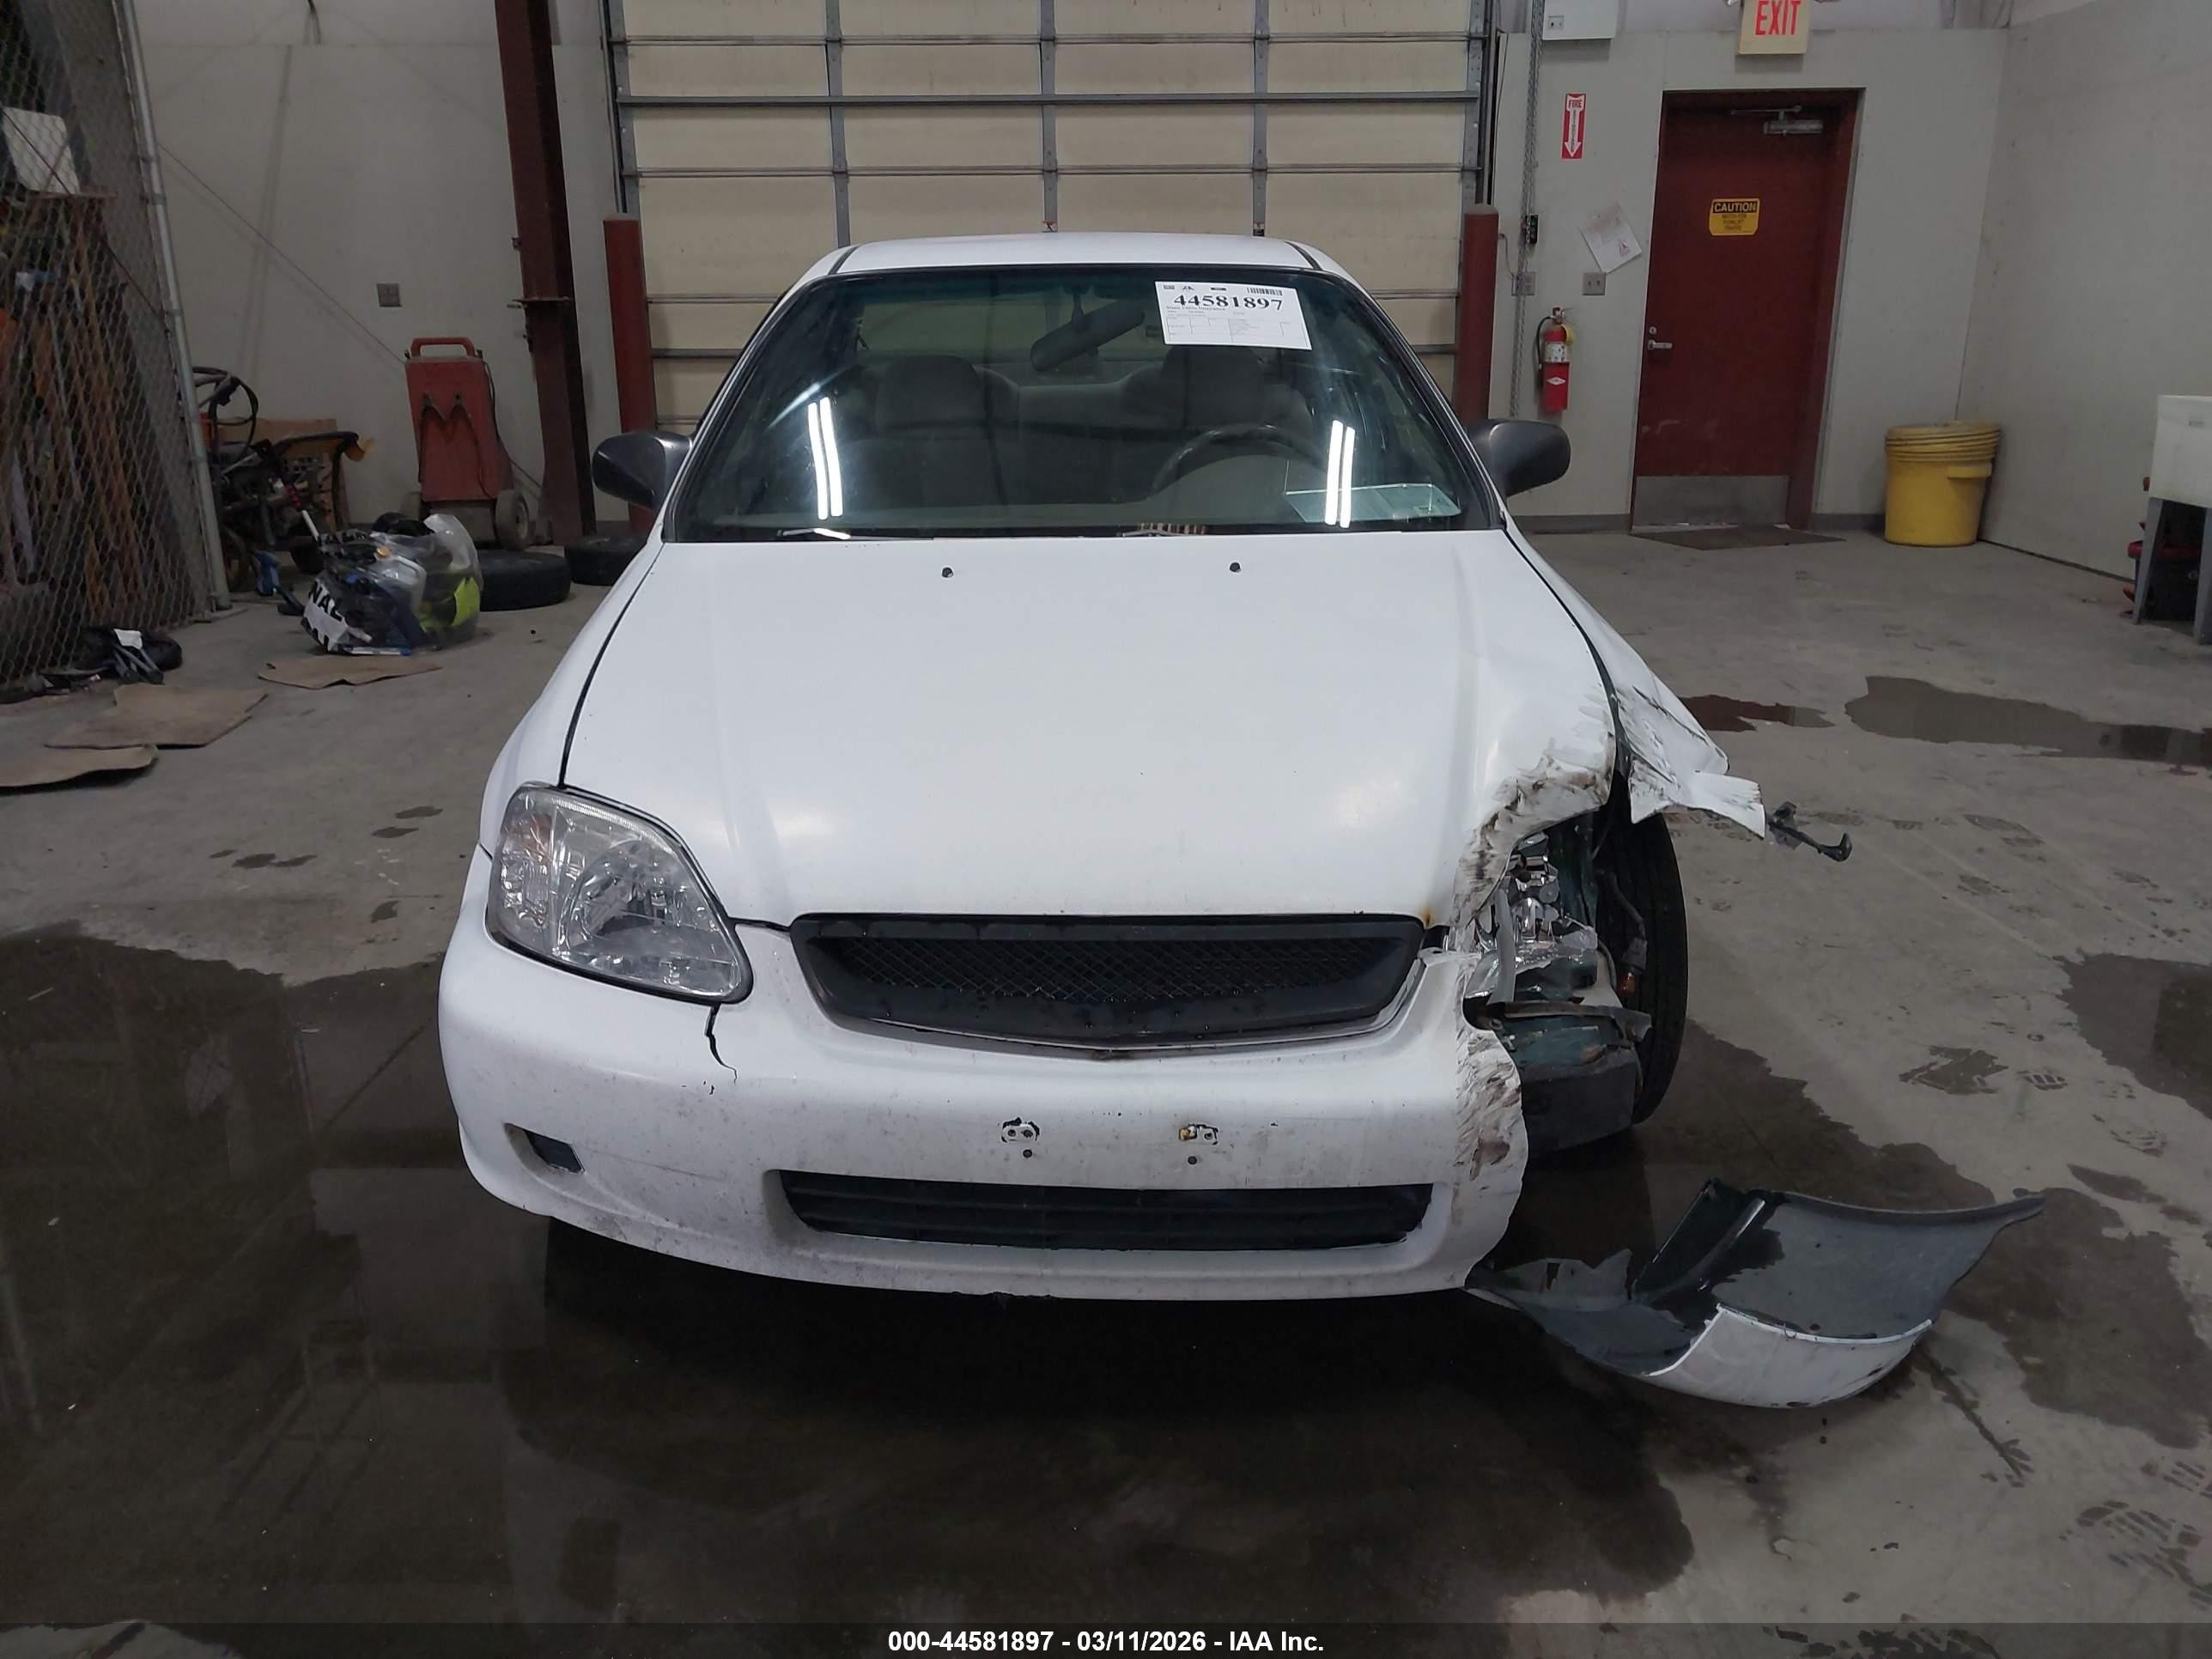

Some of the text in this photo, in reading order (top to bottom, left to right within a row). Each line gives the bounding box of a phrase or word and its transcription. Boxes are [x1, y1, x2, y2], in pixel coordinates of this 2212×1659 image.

[1755, 0, 1802, 36] EXIT
[1568, 100, 1583, 108] FIRE
[1714, 202, 1756, 213] CAUTION
[1174, 295, 1283, 311] 44581897
